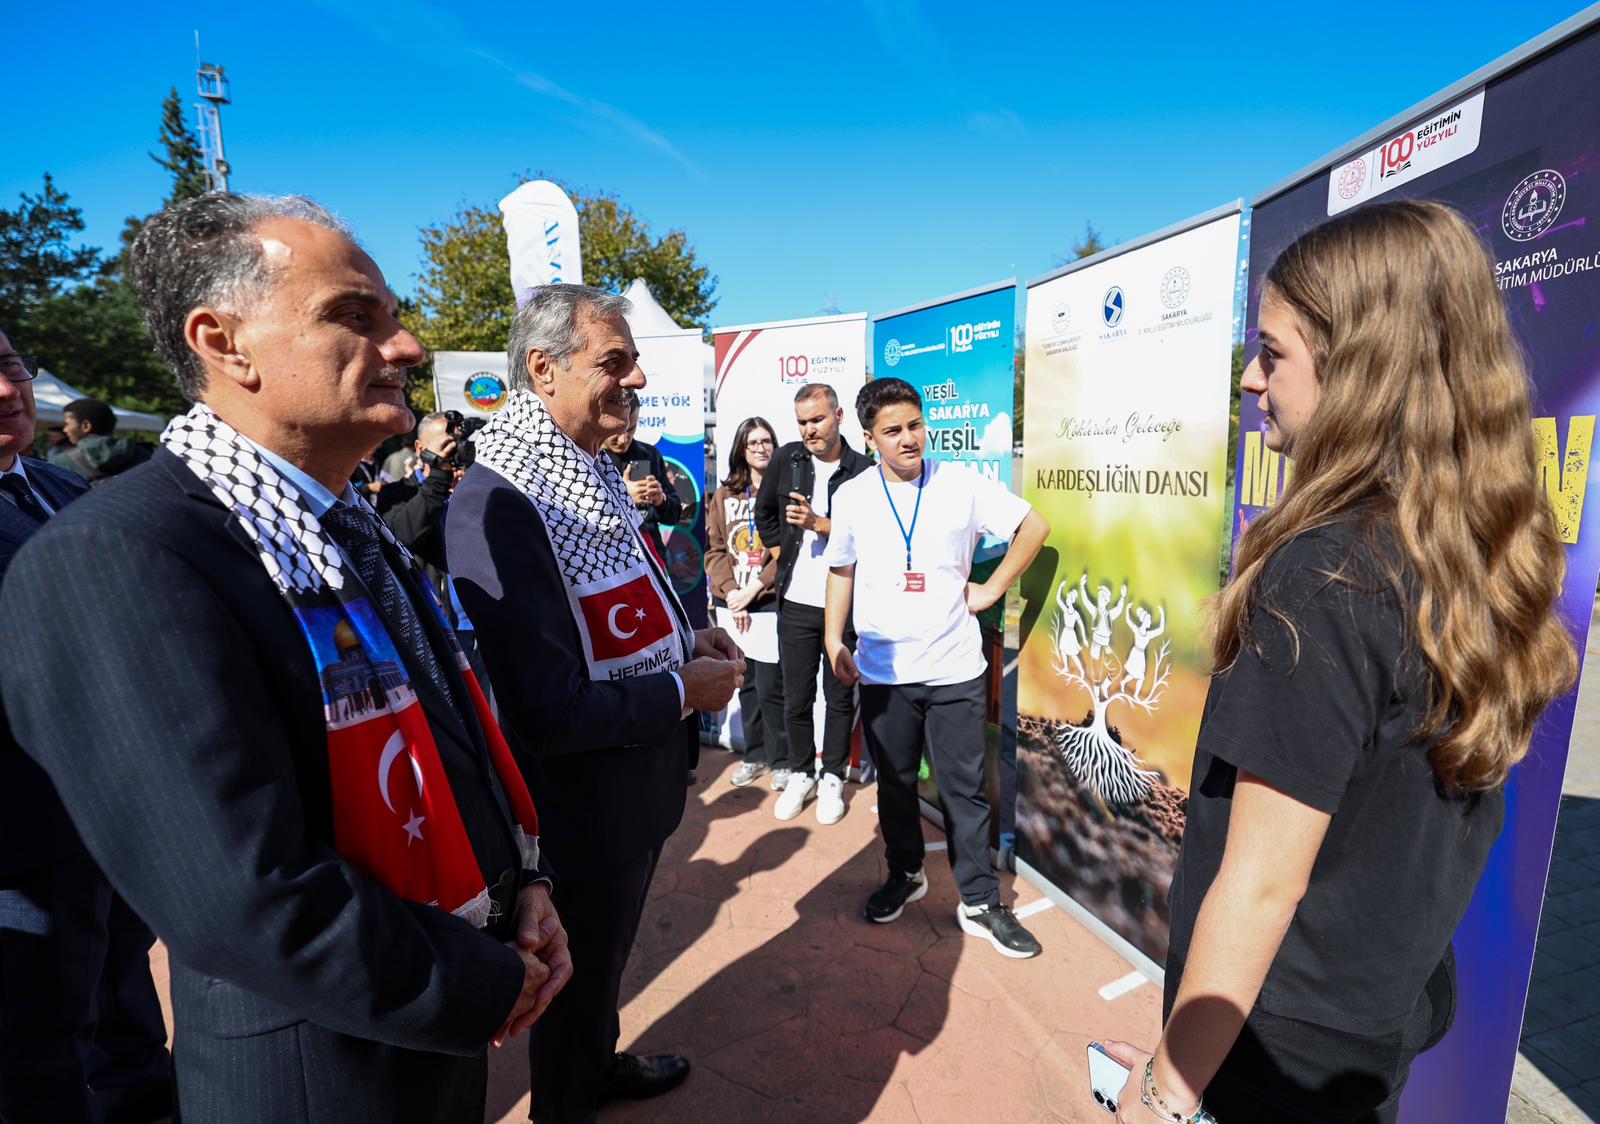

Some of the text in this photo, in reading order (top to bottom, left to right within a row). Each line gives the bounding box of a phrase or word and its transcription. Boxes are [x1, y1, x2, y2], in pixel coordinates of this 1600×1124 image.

[1416, 125, 1458, 152] YÜZYILI
[1417, 110, 1462, 140] EĞİTİMİN
[1379, 132, 1415, 179] 100
[1495, 248, 1557, 275] SAKARYA
[1496, 272, 1527, 290] İTİM
[1161, 309, 1188, 321] SAKARYA
[950, 323, 973, 353] 100
[779, 355, 808, 382] 100
[924, 379, 958, 403] YEŞİL
[929, 402, 990, 420] SAKARYA
[928, 422, 980, 457] YEŞİL
[1037, 464, 1208, 498] KARDEŞLİĞİN DANSI
[608, 647, 672, 680] HEPİMİZ
